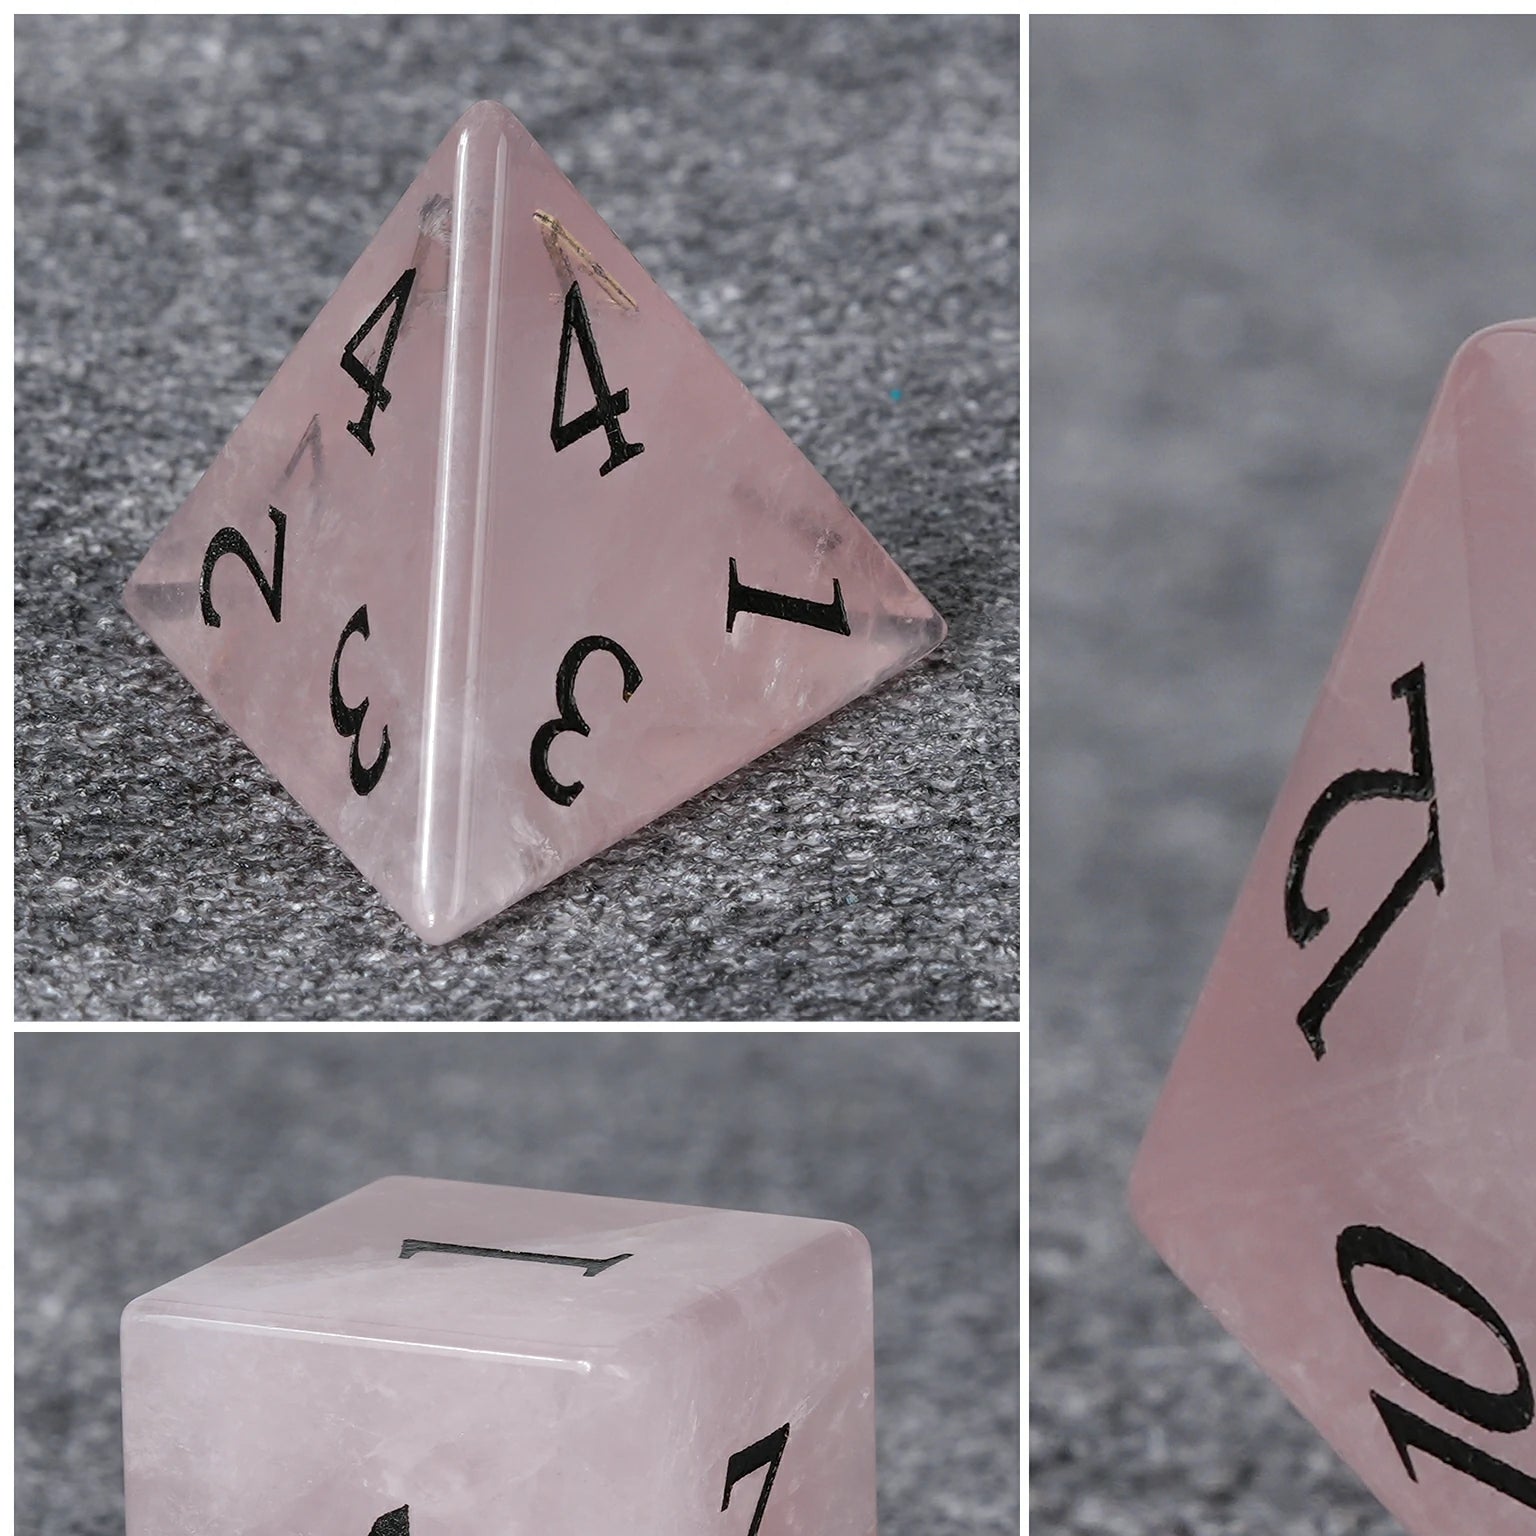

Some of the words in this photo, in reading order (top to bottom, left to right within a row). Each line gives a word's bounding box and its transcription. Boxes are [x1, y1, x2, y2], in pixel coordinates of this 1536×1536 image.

[340, 268, 416, 456] 4
[550, 280, 645, 477] 4
[199, 505, 286, 628] 2
[726, 557, 851, 636] 1
[330, 604, 391, 796] 3
[530, 635, 643, 807] 3
[1284, 662, 1445, 1061] 12
[399, 1239, 633, 1276] 1
